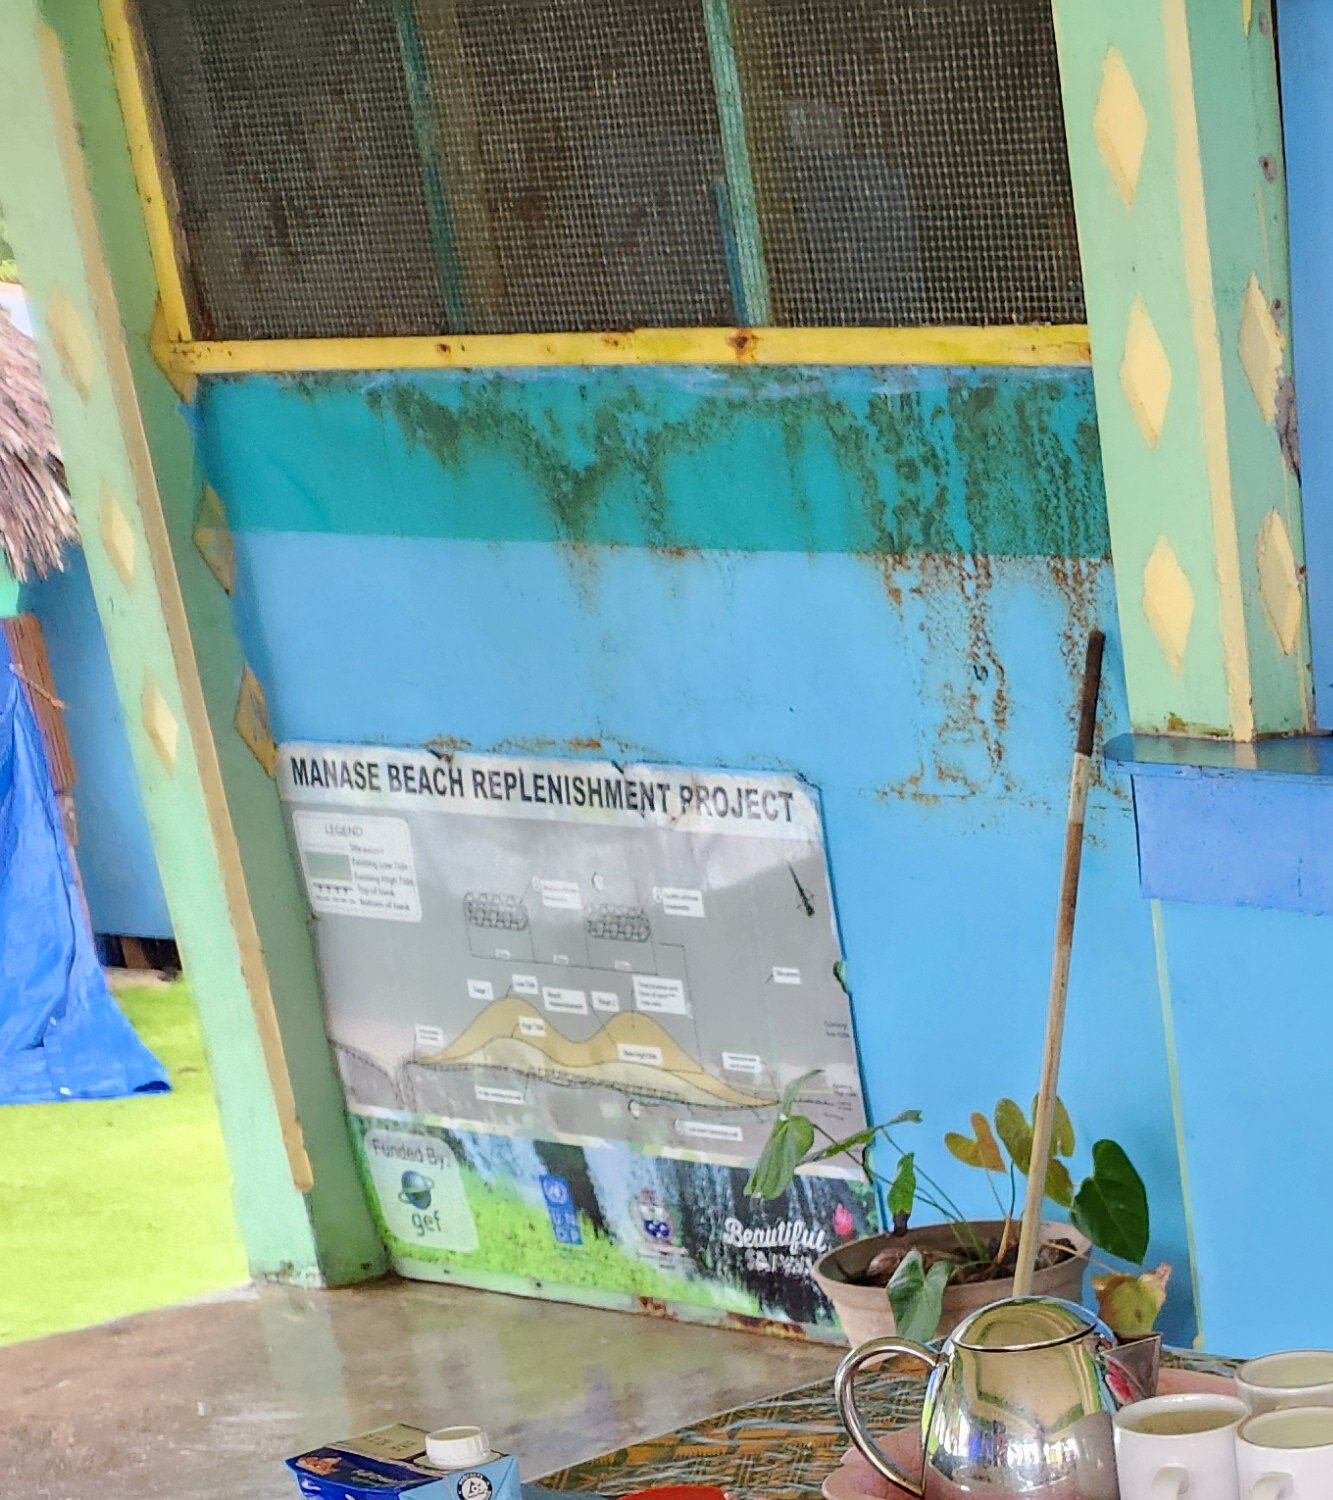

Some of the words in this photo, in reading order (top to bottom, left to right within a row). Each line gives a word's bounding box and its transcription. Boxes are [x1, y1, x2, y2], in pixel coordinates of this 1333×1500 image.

[290, 757, 382, 793] MANASE
[387, 761, 465, 797] BEACH
[472, 767, 670, 815] REPLENISHMENT
[680, 785, 793, 822] PROJECT
[372, 1138, 424, 1162] Funded
[411, 1210, 441, 1237] gef
[723, 1217, 827, 1255] Beautiful
